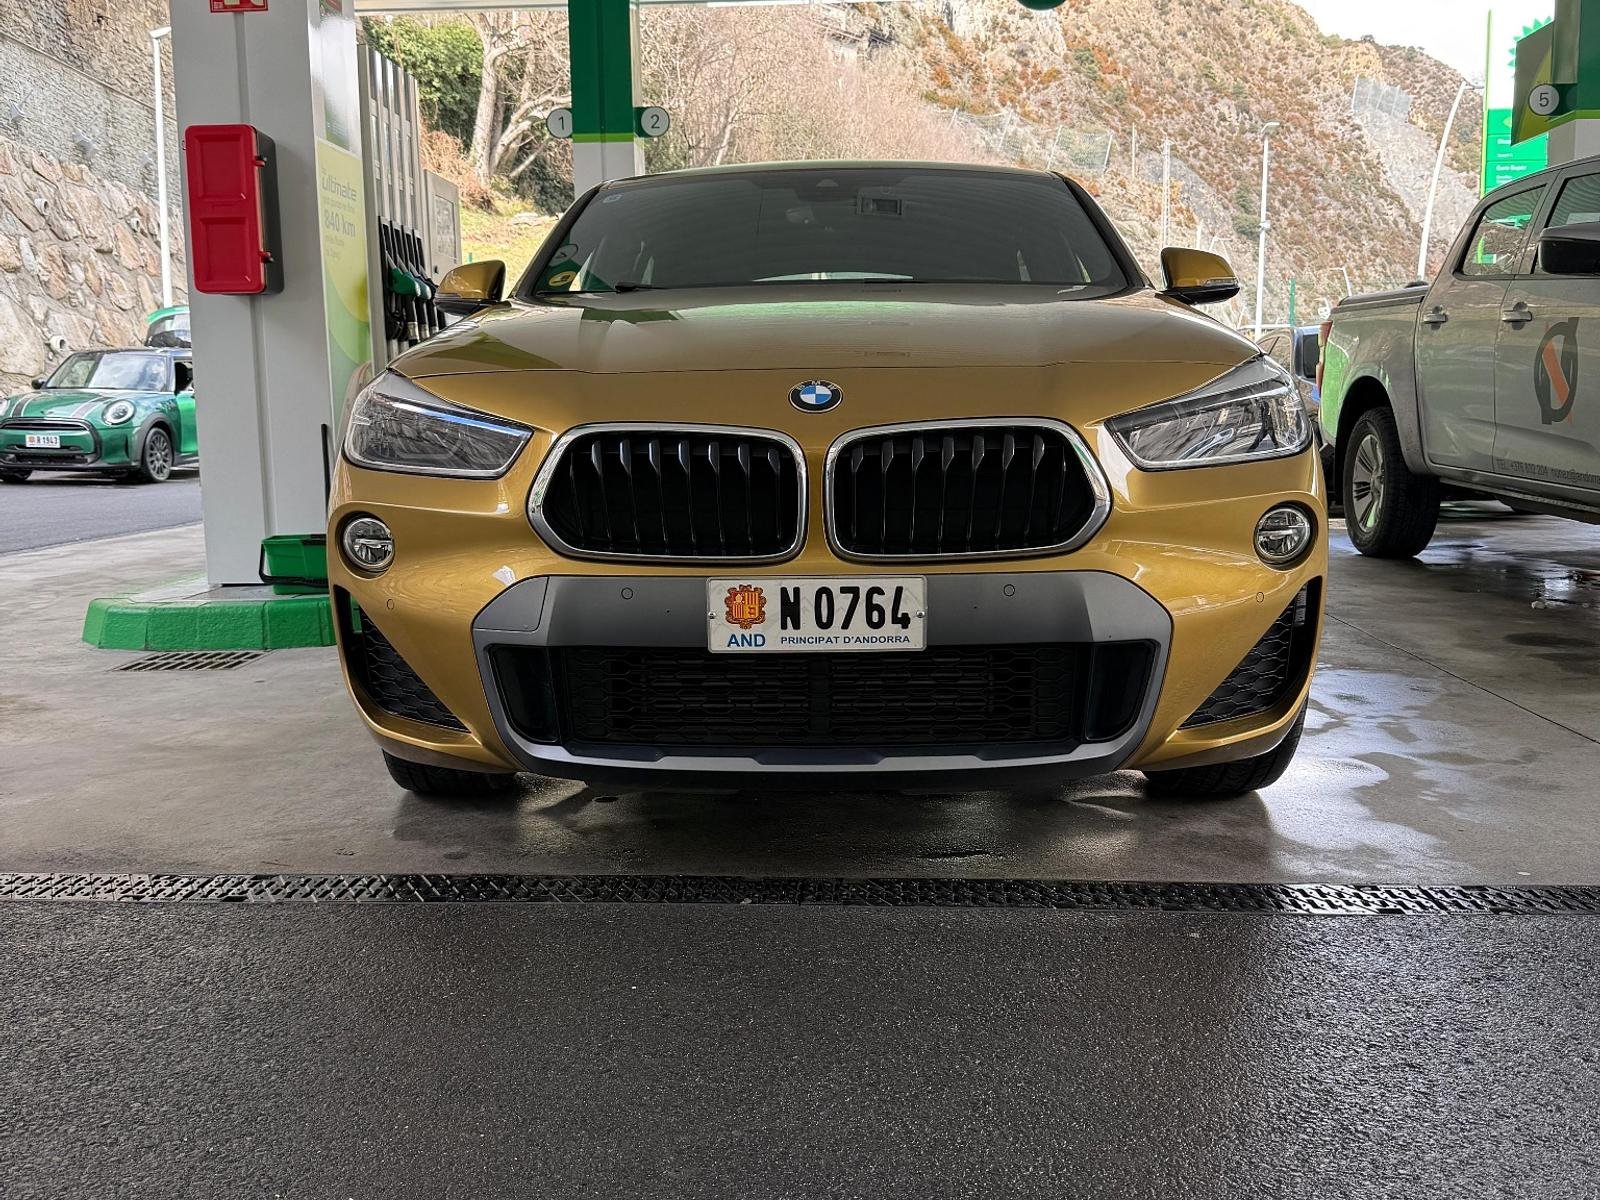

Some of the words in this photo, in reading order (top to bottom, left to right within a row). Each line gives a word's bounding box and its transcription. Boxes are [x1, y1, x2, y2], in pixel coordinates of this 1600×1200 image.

[1539, 92, 1549, 107] 5
[558, 116, 565, 130] 1
[650, 114, 660, 129] 2
[321, 176, 357, 201] ultimate
[323, 210, 340, 233] 840
[780, 586, 800, 630] N
[814, 586, 911, 630] 0764
[727, 634, 766, 647] AND
[781, 636, 840, 645] PRINCIPAT
[843, 635, 910, 644] D'ANDORRA
